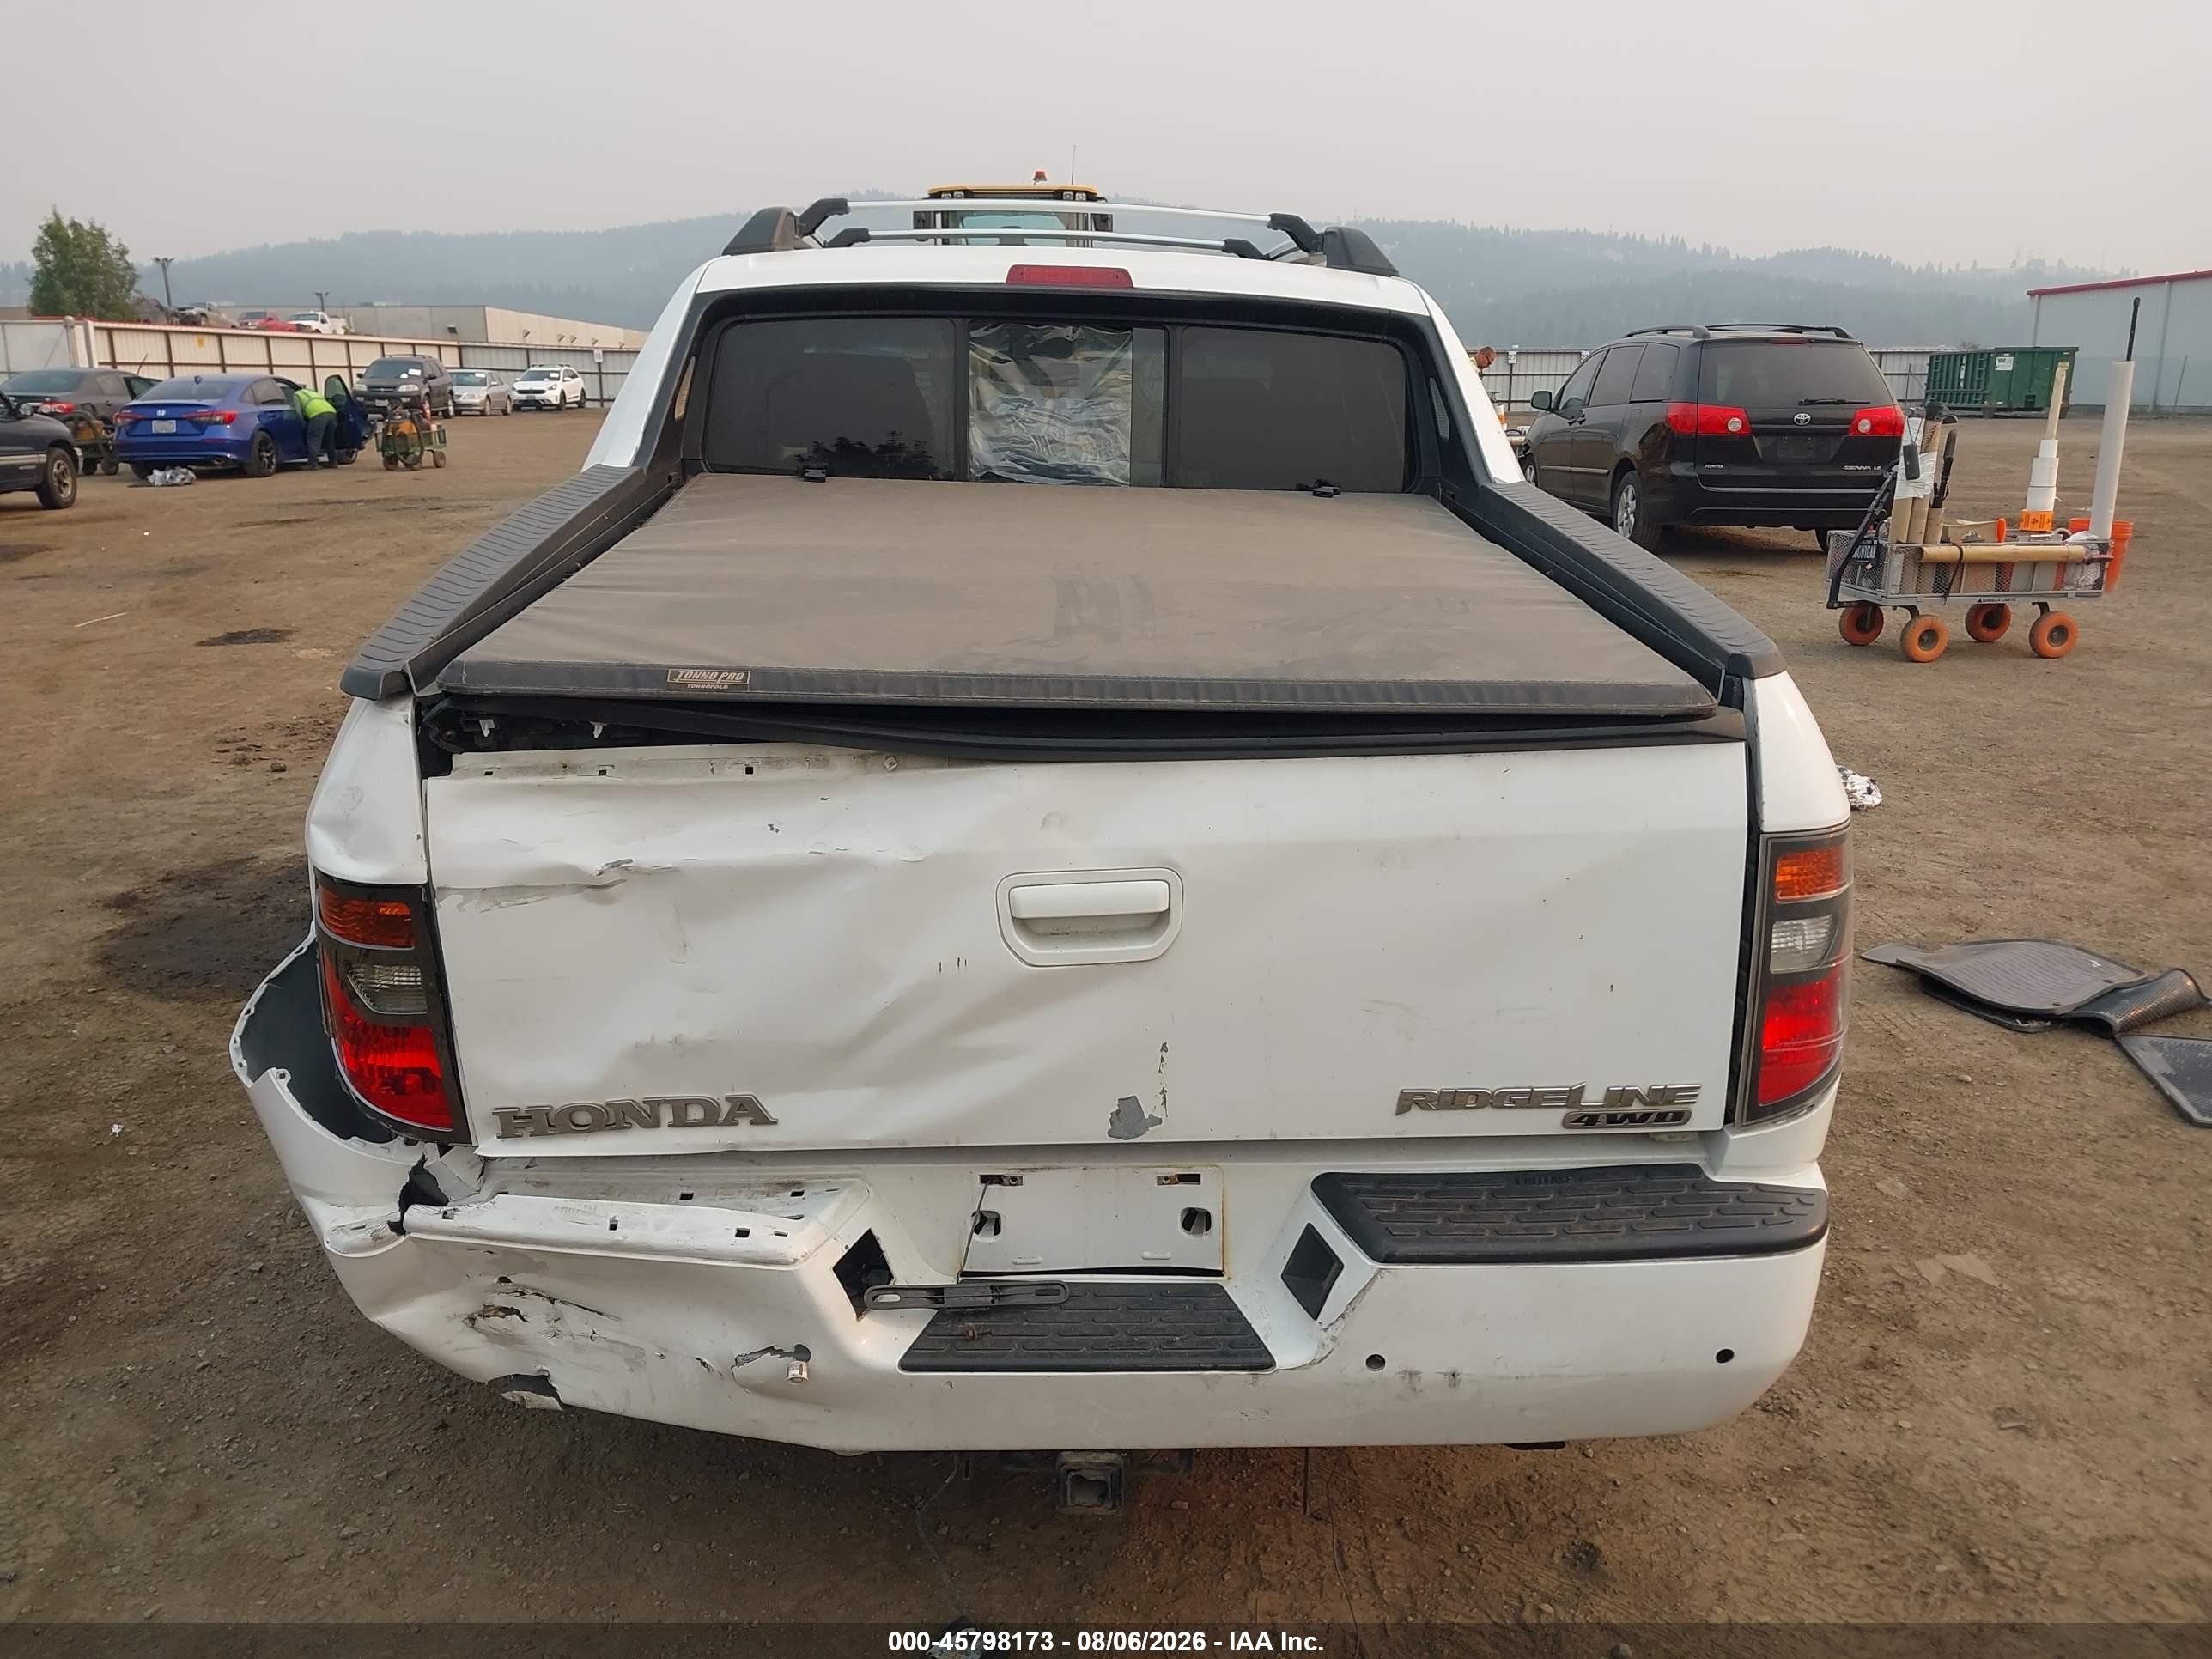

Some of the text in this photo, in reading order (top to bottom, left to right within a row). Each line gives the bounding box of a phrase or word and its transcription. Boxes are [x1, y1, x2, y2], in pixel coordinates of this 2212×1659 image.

[673, 671, 745, 684] TONNO PRO
[1395, 1081, 1703, 1115] RIDGELINE
[492, 1094, 778, 1139] HONDA
[1569, 1109, 1684, 1128] 4WD
